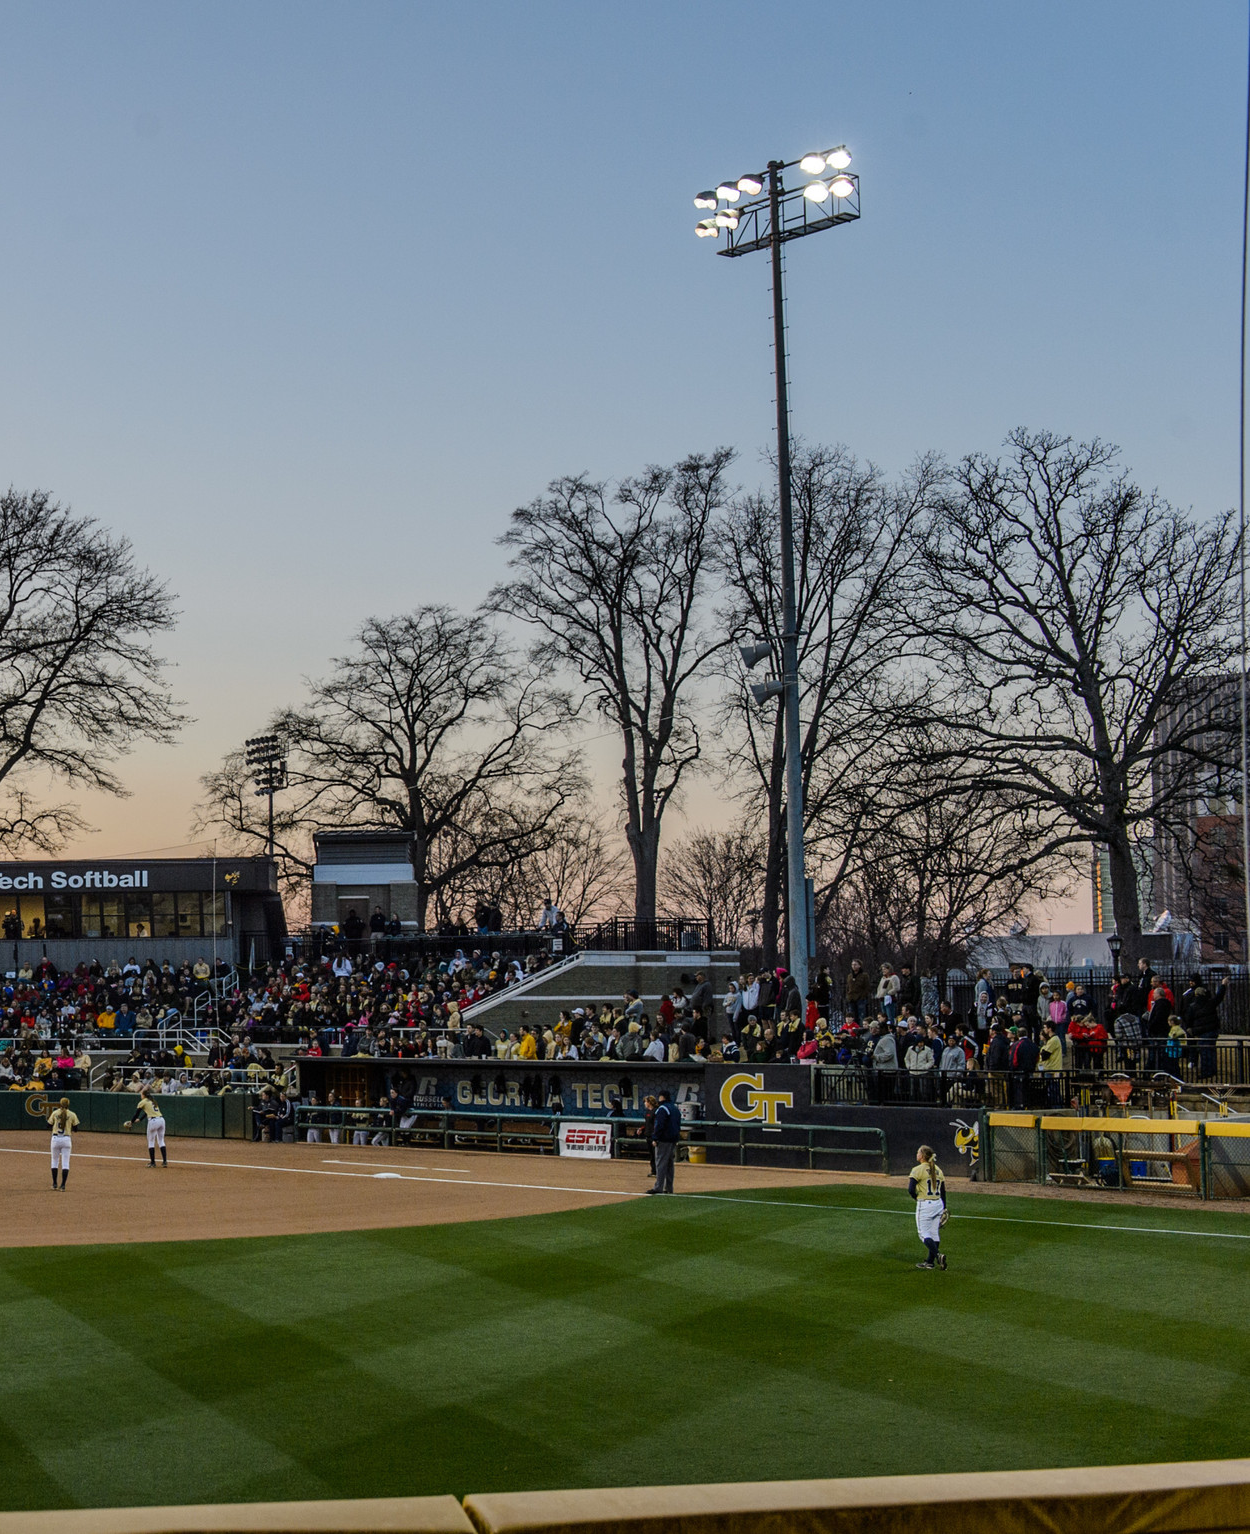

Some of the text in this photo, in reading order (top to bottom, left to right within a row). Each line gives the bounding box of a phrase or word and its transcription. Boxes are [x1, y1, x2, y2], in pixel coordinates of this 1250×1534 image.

[51, 870, 148, 889] Softball
[572, 1083, 638, 1110] TECH
[719, 1072, 793, 1132] GT
[566, 1129, 607, 1144] ESPN
